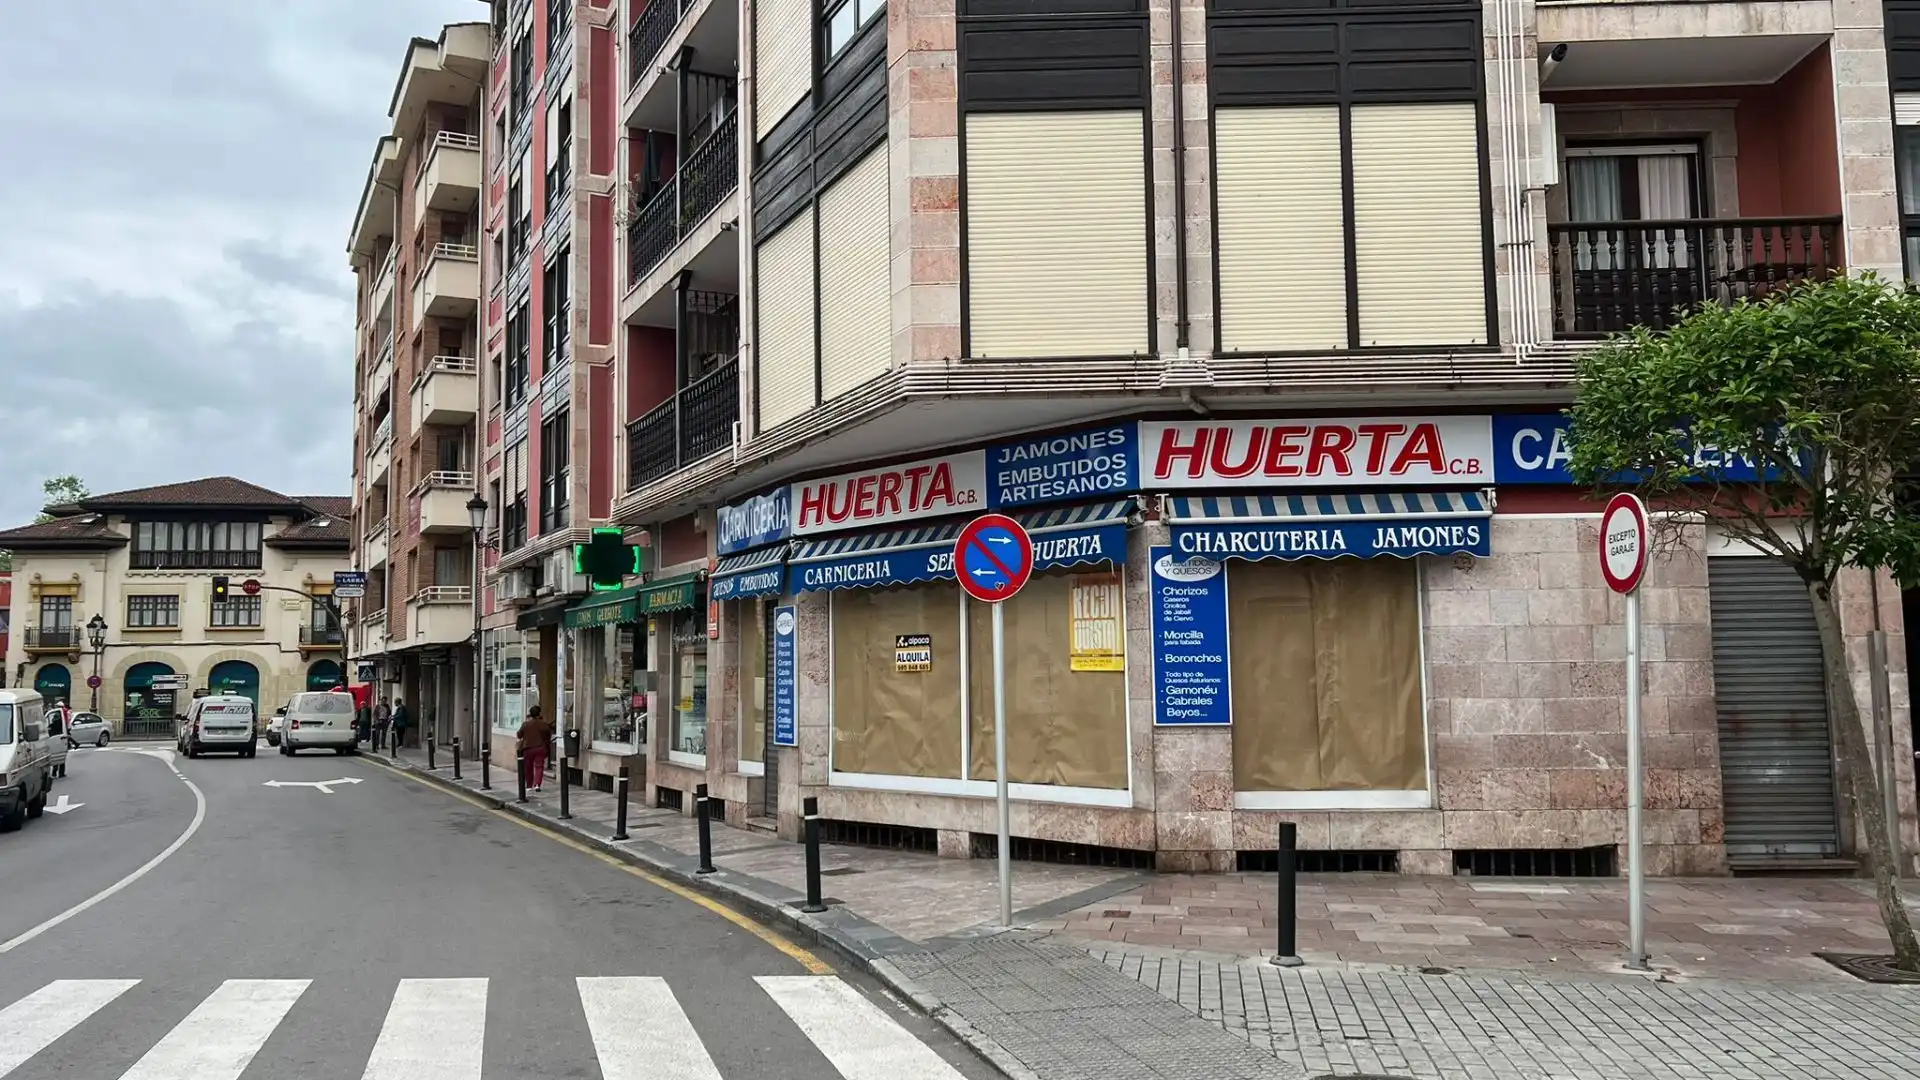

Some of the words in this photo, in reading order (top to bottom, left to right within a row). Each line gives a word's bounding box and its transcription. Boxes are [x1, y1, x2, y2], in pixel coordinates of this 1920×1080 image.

[998, 428, 1126, 464] JAMONES
[1153, 423, 1450, 479] HUERTA
[1450, 459, 1483, 474] C.B.
[998, 453, 1127, 487] EMBUTIDOS
[798, 461, 956, 528] HUERTA
[956, 489, 978, 505] C.B.
[1000, 471, 1128, 503] ARTESANOS
[1178, 528, 1347, 553] CHARCUTERIA
[1372, 525, 1481, 549] JAMONES
[1609, 528, 1636, 544] EXCEPTO
[1611, 542, 1635, 556] GARAJE
[804, 560, 891, 586] CARNICERIA
[1032, 535, 1103, 562] HUERTA
[1173, 567, 1212, 576] QUESOS
[739, 571, 779, 592] EMBUTIDOS
[1162, 586, 1208, 596] Chorizos
[1164, 630, 1204, 640] Morcilla
[896, 651, 929, 662] ALQUILA
[1165, 654, 1222, 663] Boronchos
[1165, 685, 1218, 695] Gamonéu
[1165, 696, 1213, 706] Cabrales
[1166, 707, 1208, 718] Beyos...
